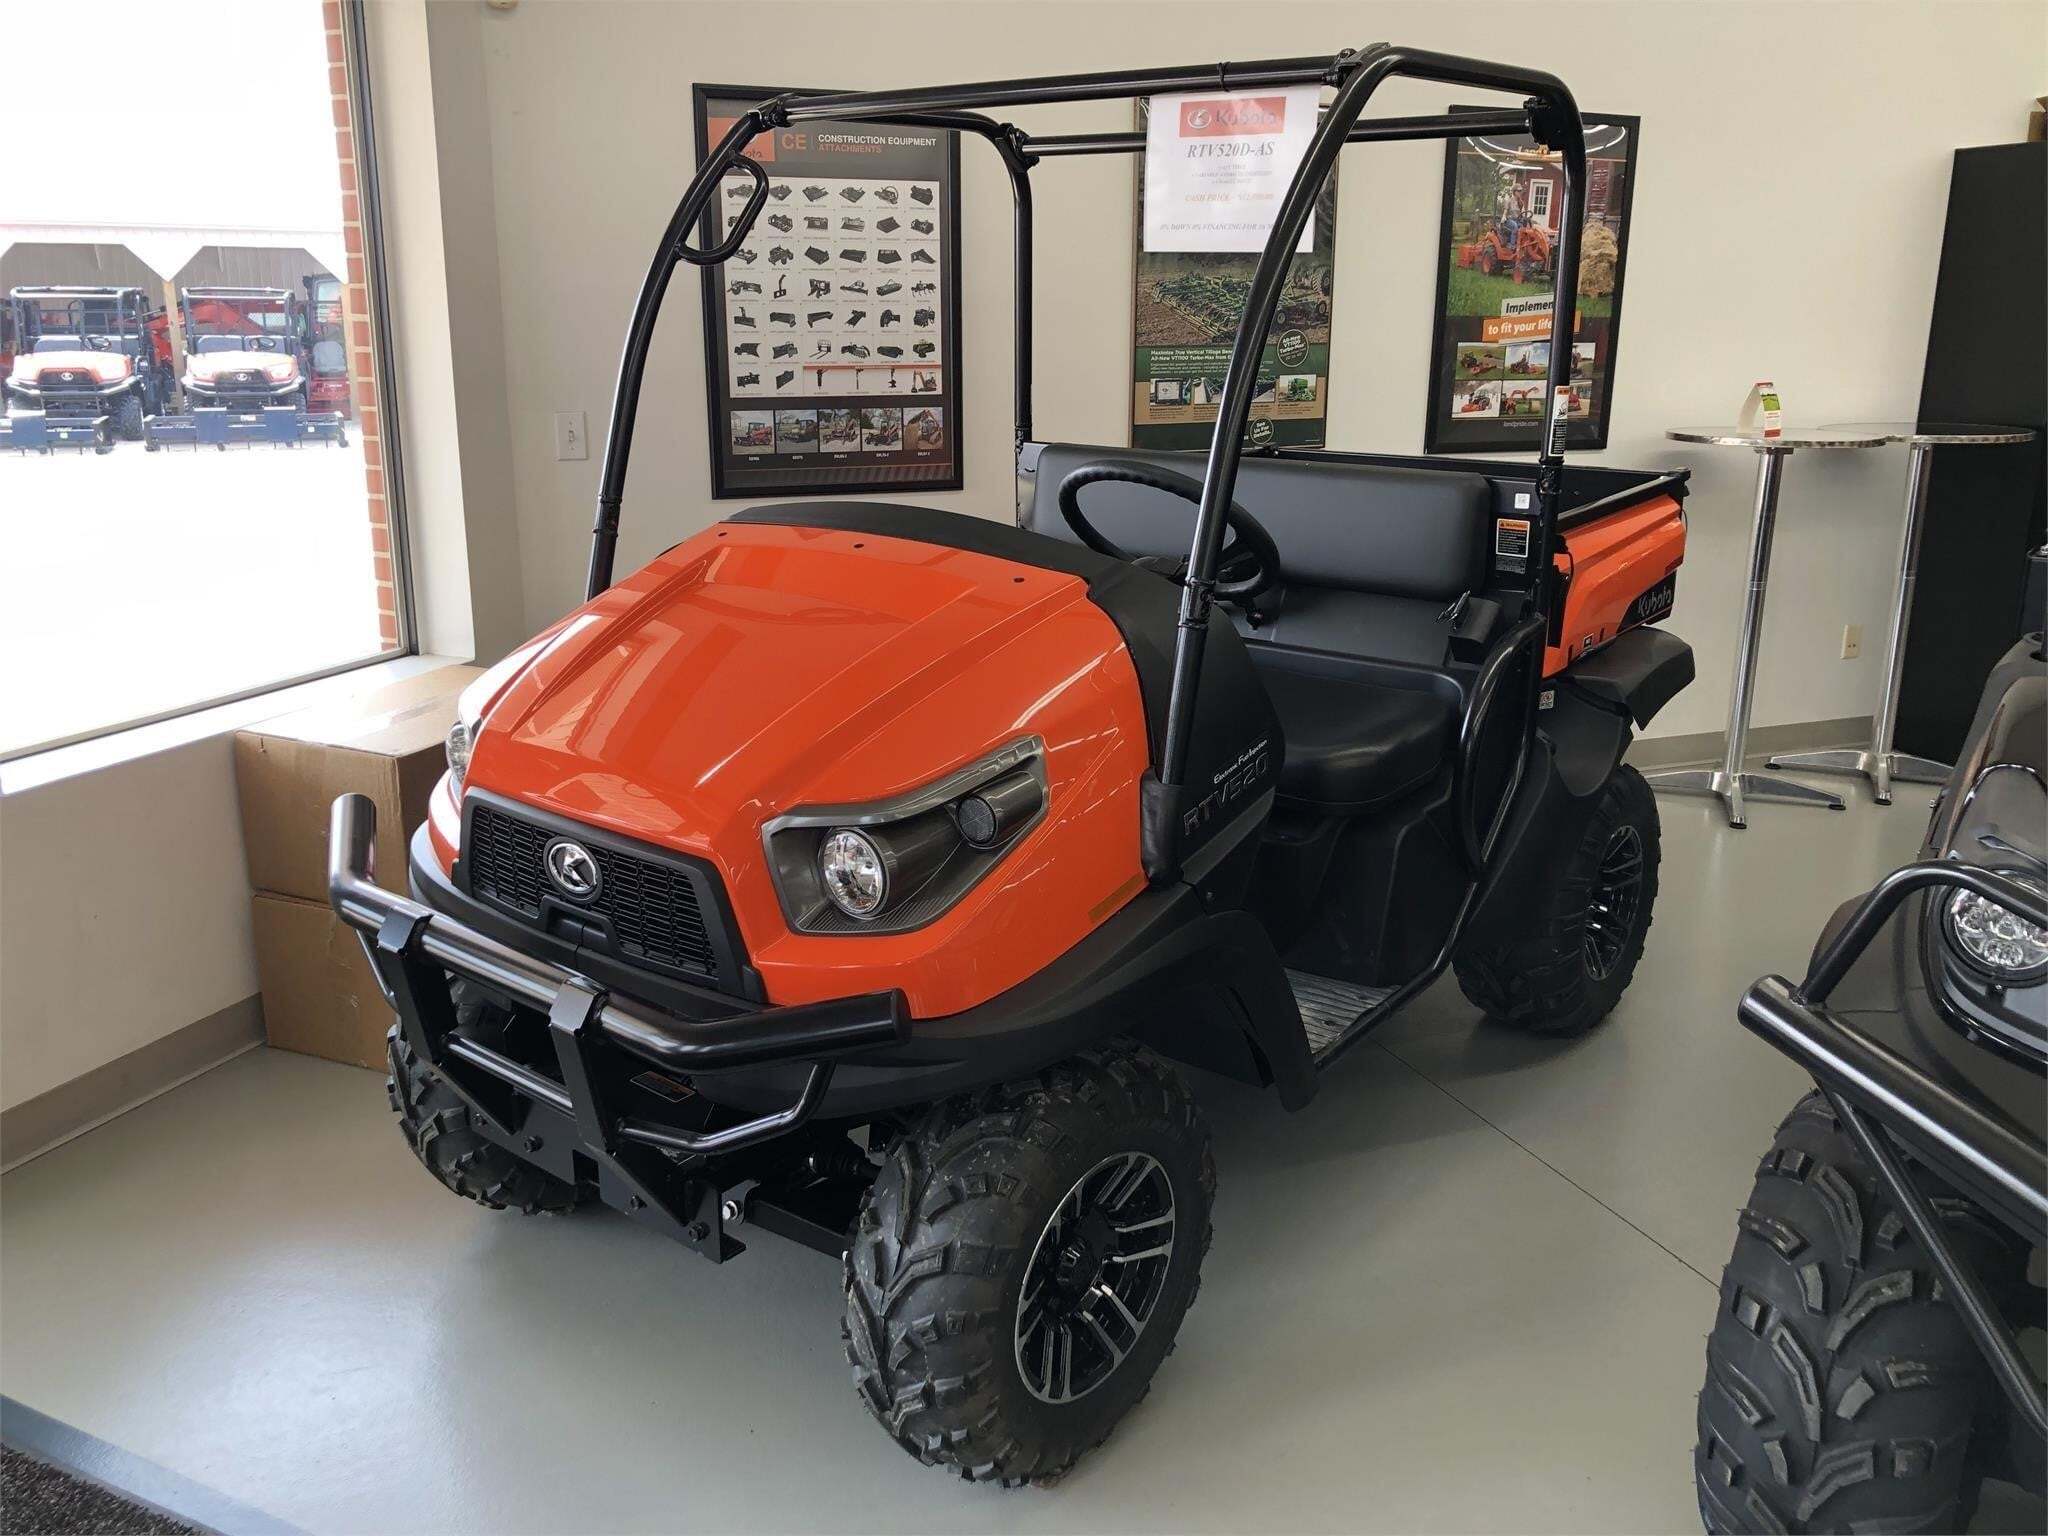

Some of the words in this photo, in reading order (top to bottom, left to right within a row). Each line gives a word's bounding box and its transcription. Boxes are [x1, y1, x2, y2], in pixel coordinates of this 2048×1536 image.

[1215, 108, 1277, 128] Kubota
[782, 133, 807, 150] CE
[818, 134, 886, 145] CONSTRUCTION
[887, 137, 937, 147] EQUIPMENT
[818, 144, 883, 154] ATTACHMENTS
[1187, 141, 1275, 159] RTV520D-AS
[1505, 301, 1554, 315] Implemen
[1488, 324, 1499, 335] to
[1501, 321, 1512, 334] fit
[1514, 322, 1537, 336] your
[1538, 318, 1552, 330] life
[1638, 585, 1672, 617] Kubota
[1183, 751, 1269, 836] RTV520
